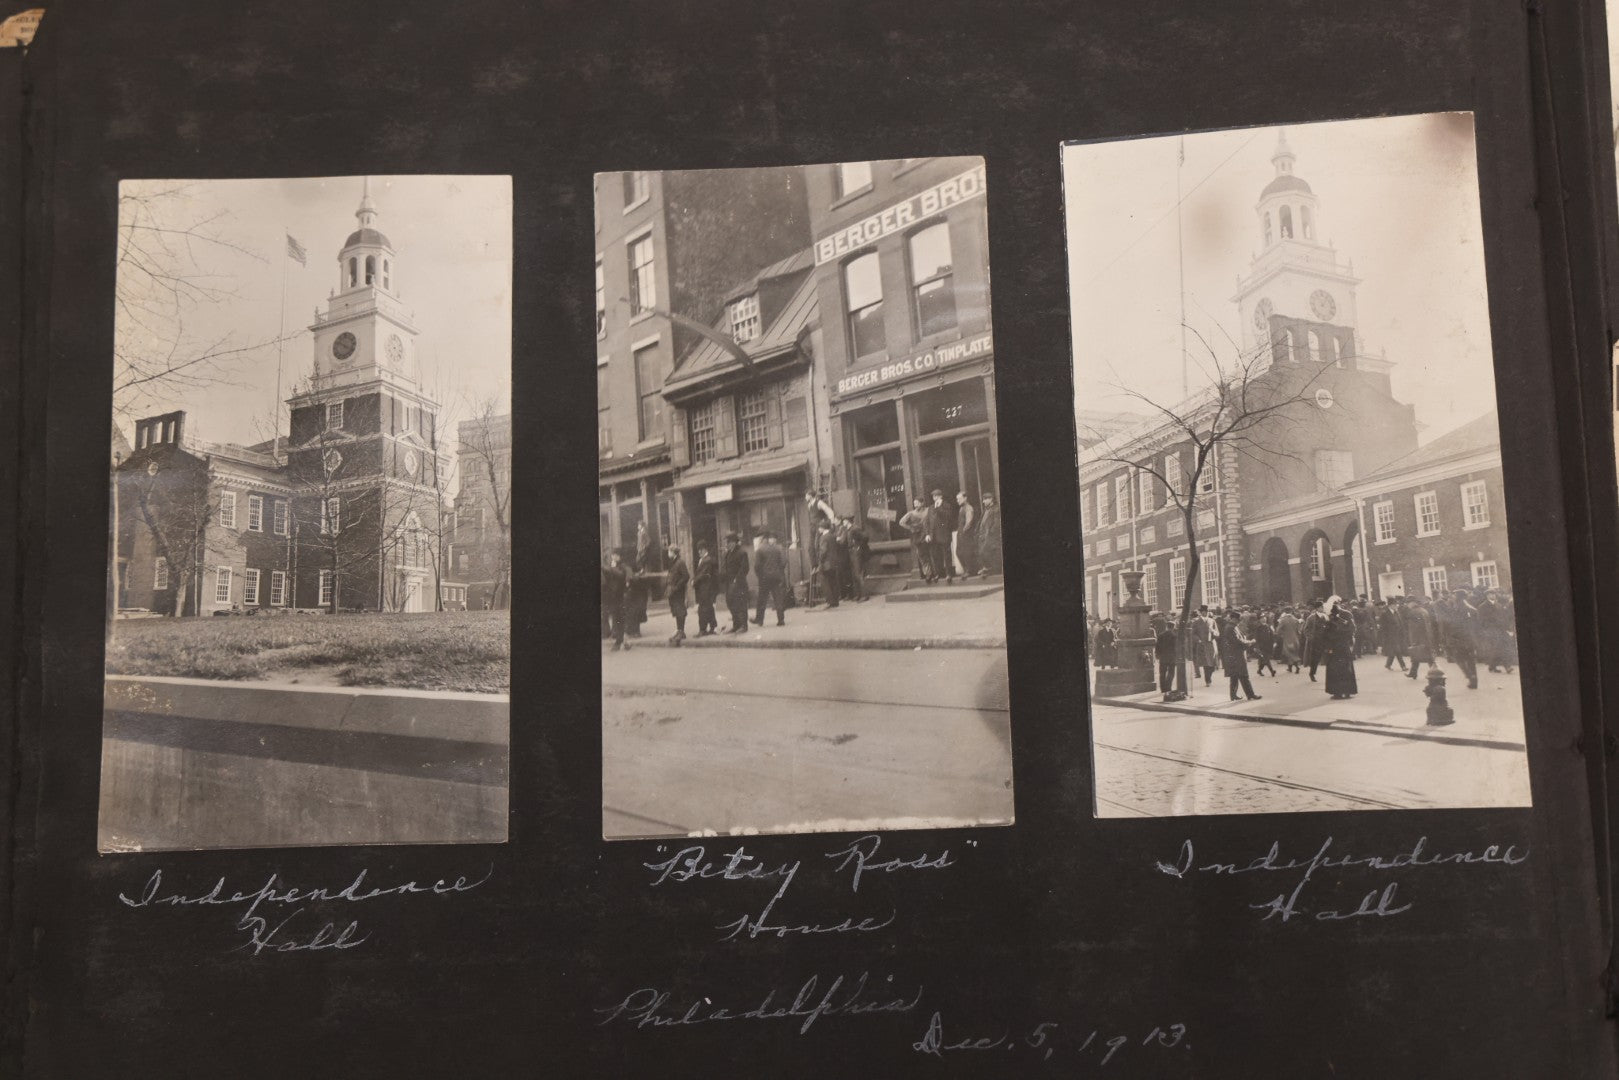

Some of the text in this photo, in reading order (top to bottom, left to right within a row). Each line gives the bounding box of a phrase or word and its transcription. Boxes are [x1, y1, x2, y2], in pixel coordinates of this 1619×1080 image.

[819, 201, 915, 260] BERGER
[838, 370, 878, 393] BERGER
[119, 862, 494, 922] Independence
[1249, 880, 1412, 922] Hall
[236, 907, 373, 956] Hall
[714, 899, 896, 942] House
